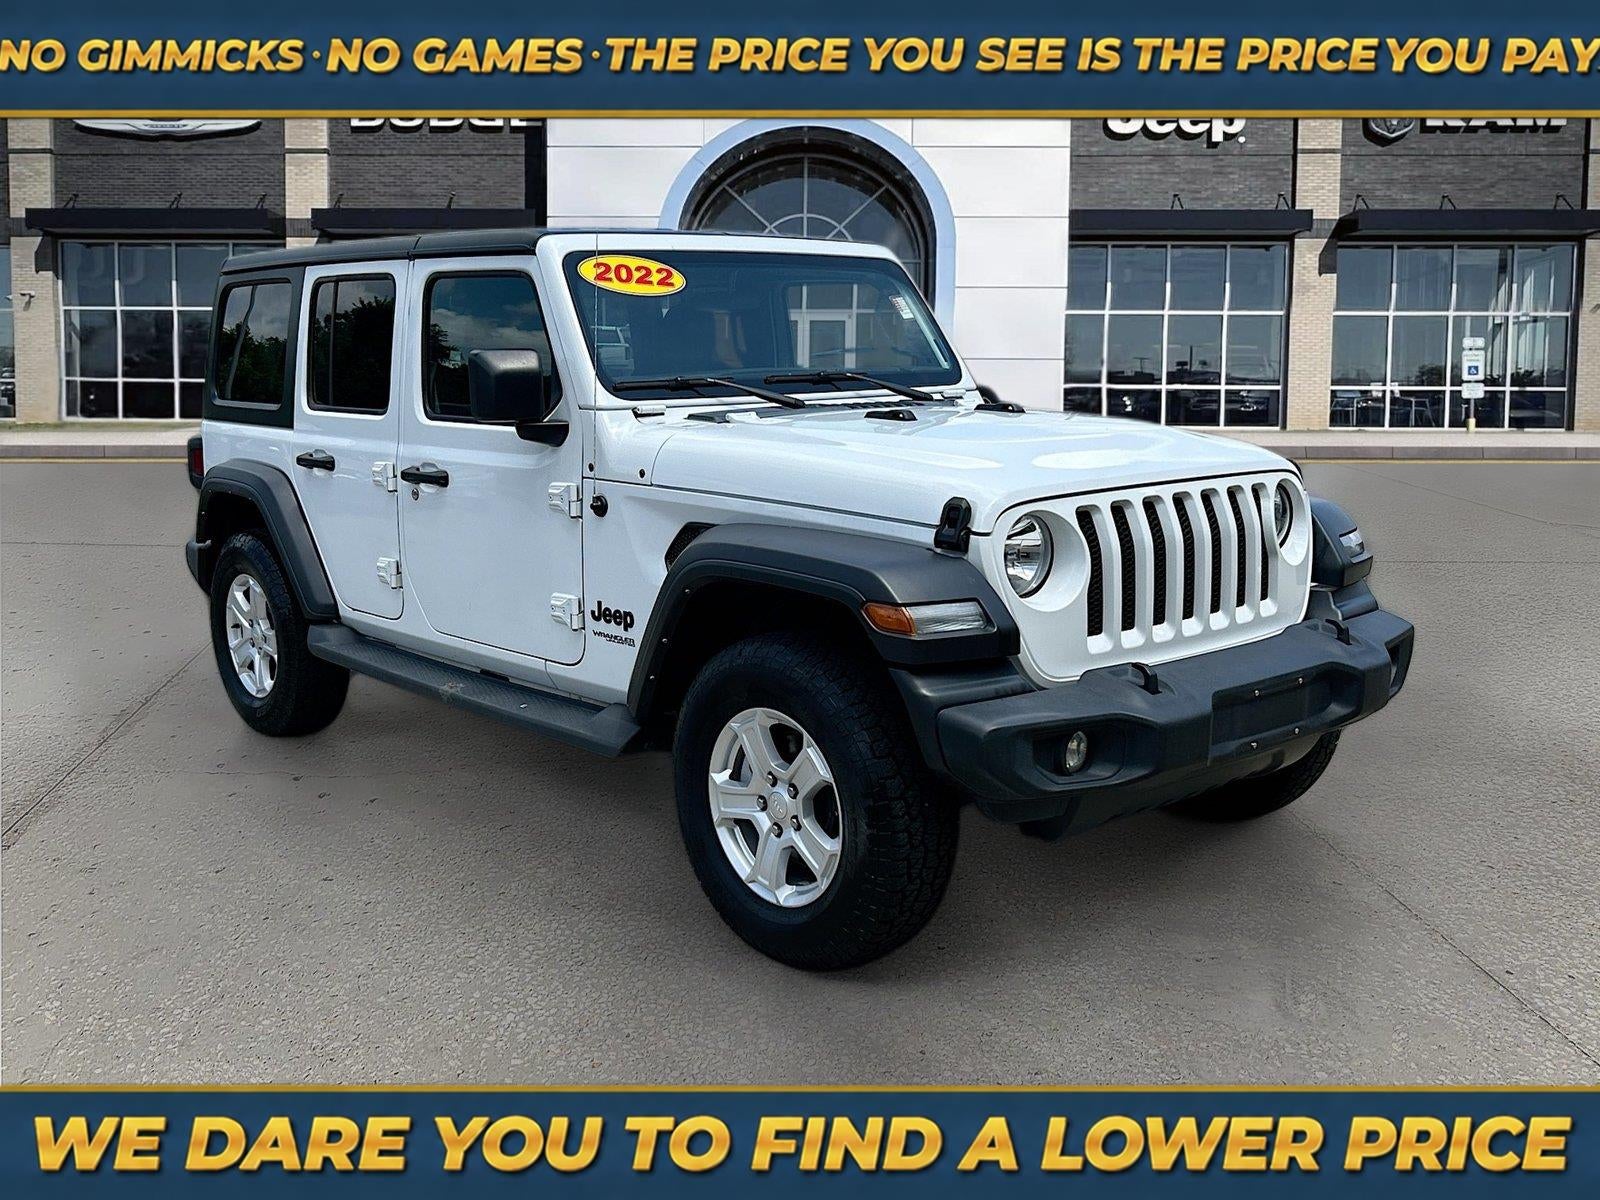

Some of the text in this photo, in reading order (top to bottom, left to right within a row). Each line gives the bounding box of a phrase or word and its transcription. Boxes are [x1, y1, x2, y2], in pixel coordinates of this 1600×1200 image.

[593, 262, 675, 287] 2022
[590, 600, 635, 632] Jeep
[592, 629, 635, 645] WRANGLER
